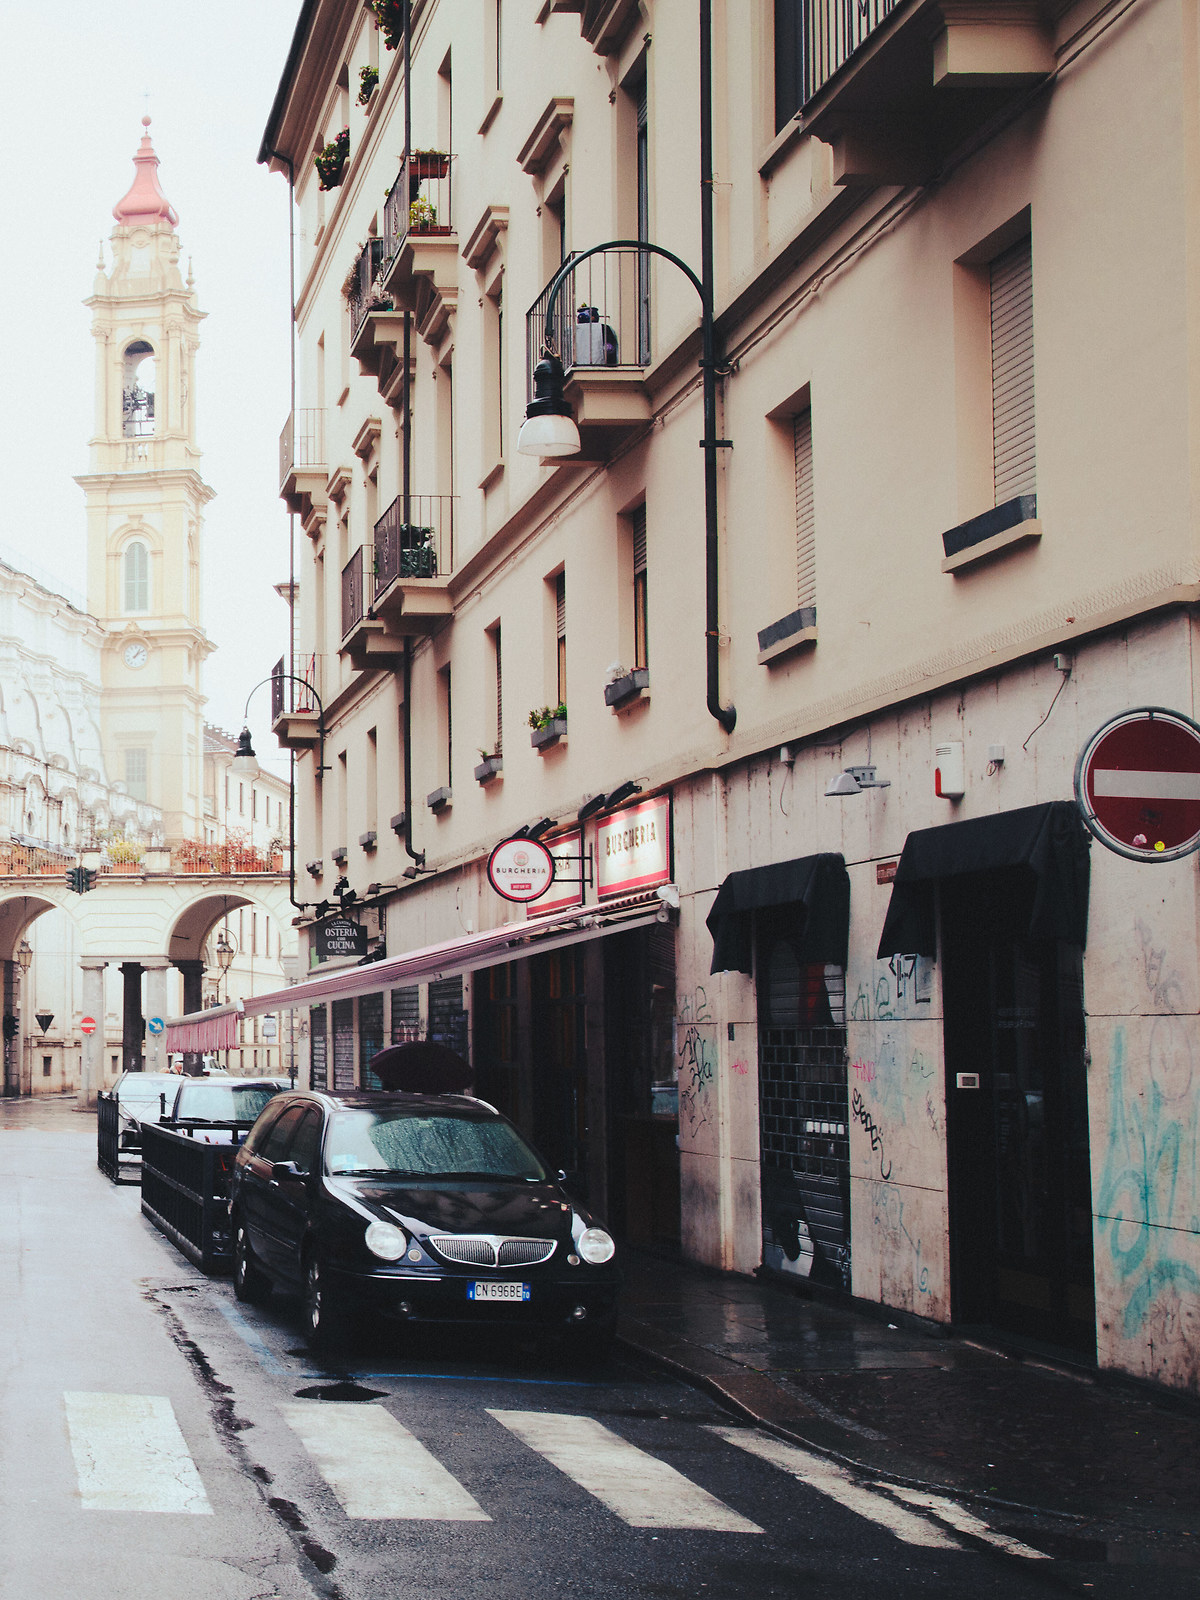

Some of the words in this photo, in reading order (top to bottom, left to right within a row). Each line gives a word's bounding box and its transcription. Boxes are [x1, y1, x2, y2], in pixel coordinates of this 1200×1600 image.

[605, 821, 657, 857] BURGHERIA
[496, 867, 547, 875] BURGHERIA
[325, 928, 358, 937] OSTERIA
[327, 940, 356, 950] CUCINA
[475, 1284, 488, 1296] CN
